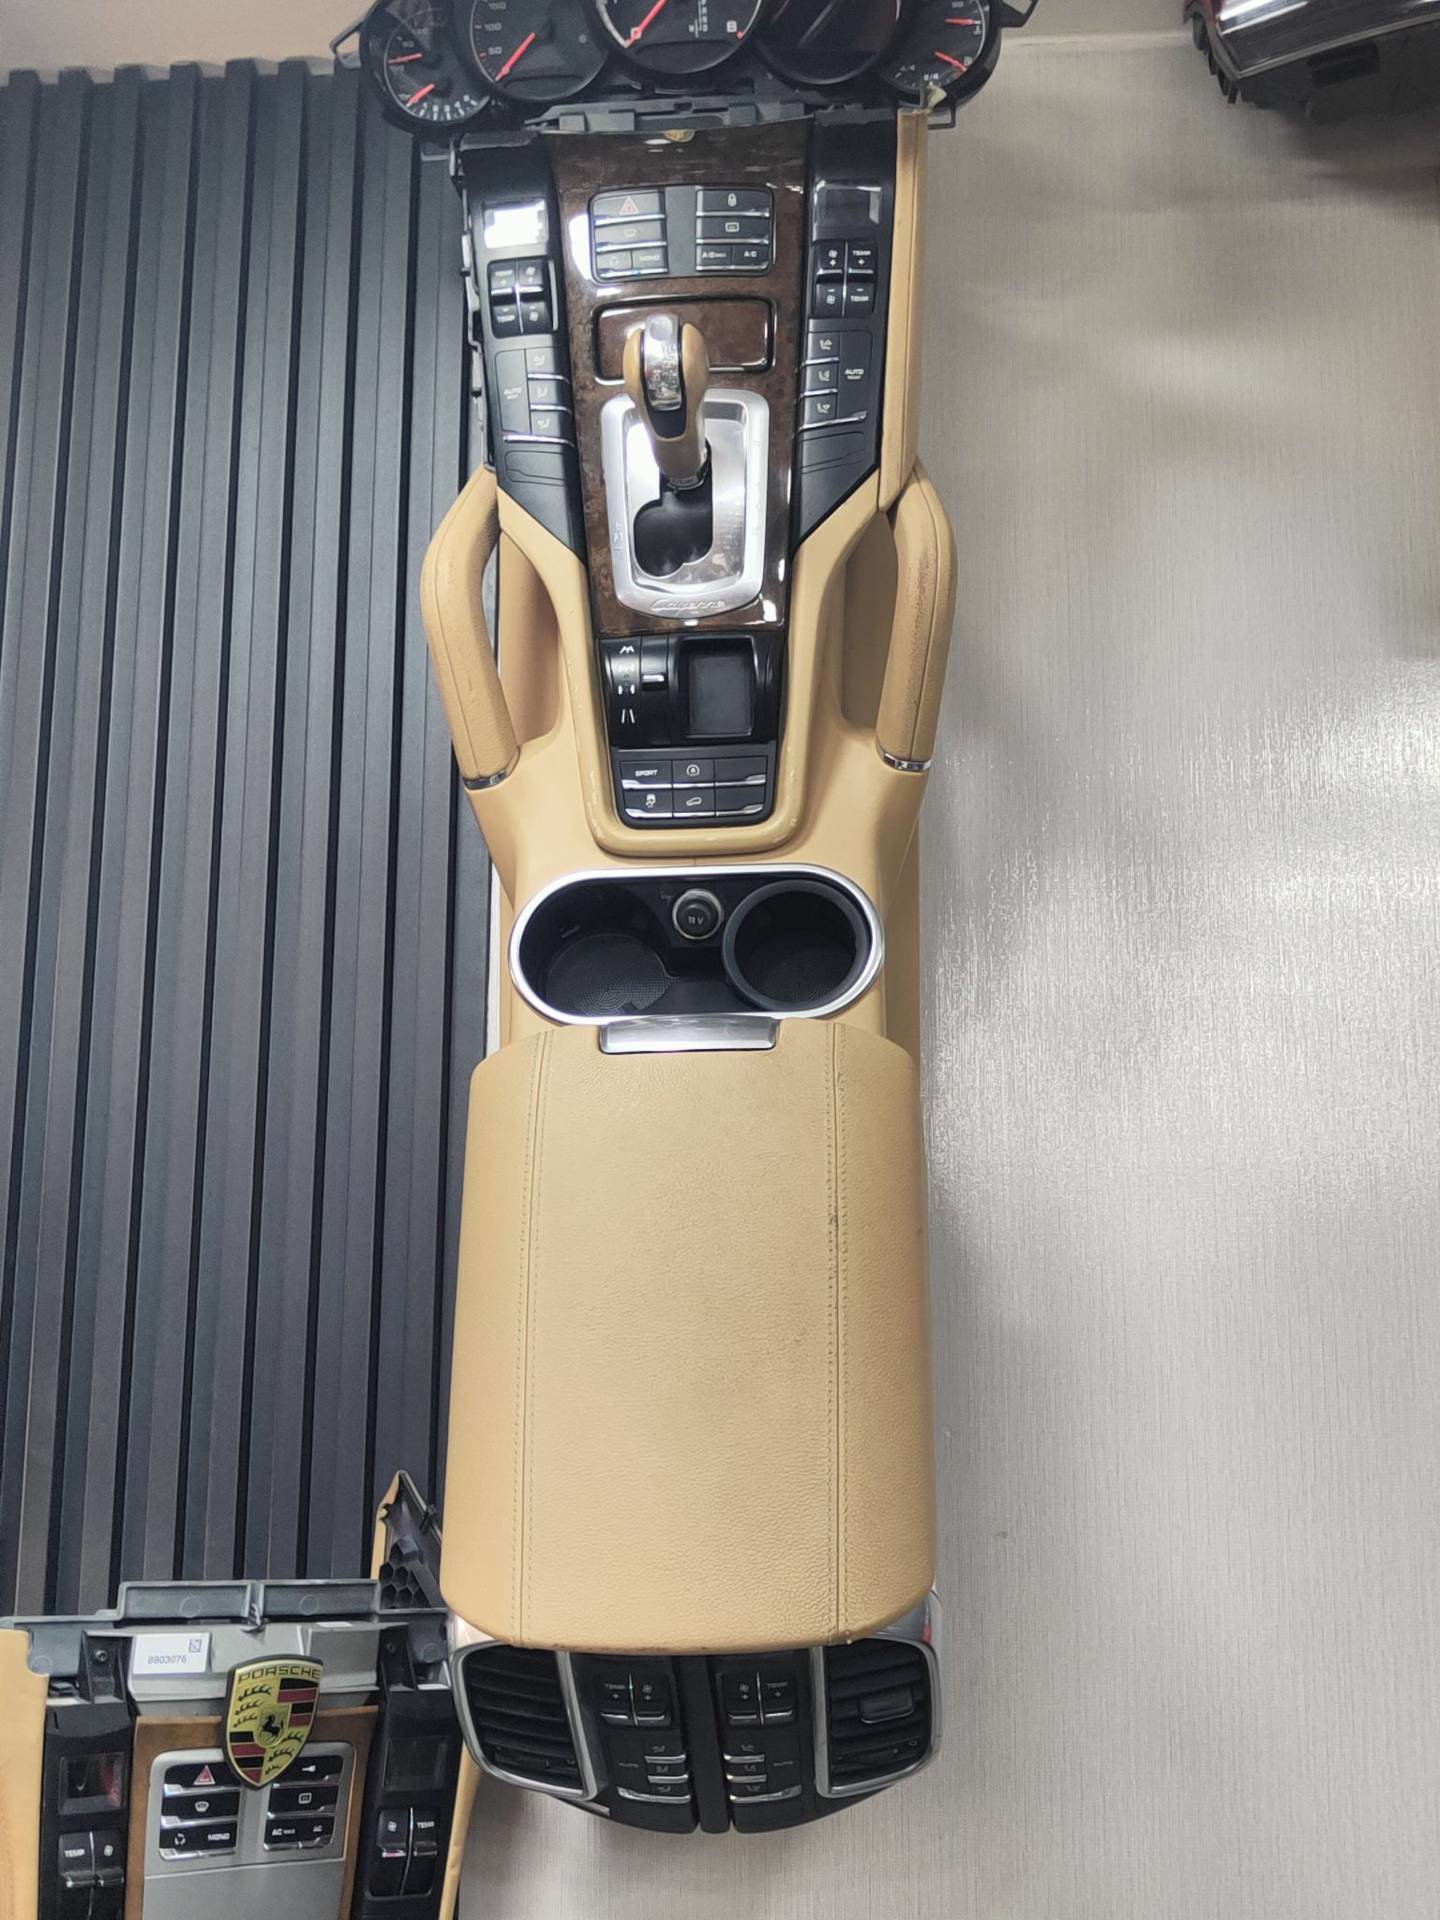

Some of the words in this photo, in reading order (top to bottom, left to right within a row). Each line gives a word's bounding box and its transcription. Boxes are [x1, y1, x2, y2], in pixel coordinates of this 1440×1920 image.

[743, 250, 757, 258] AC
[634, 769, 659, 778] SPORT
[239, 1665, 321, 1684] PORSCHE
[207, 1832, 231, 1841] MONO
[63, 1848, 86, 1858] TEMP
